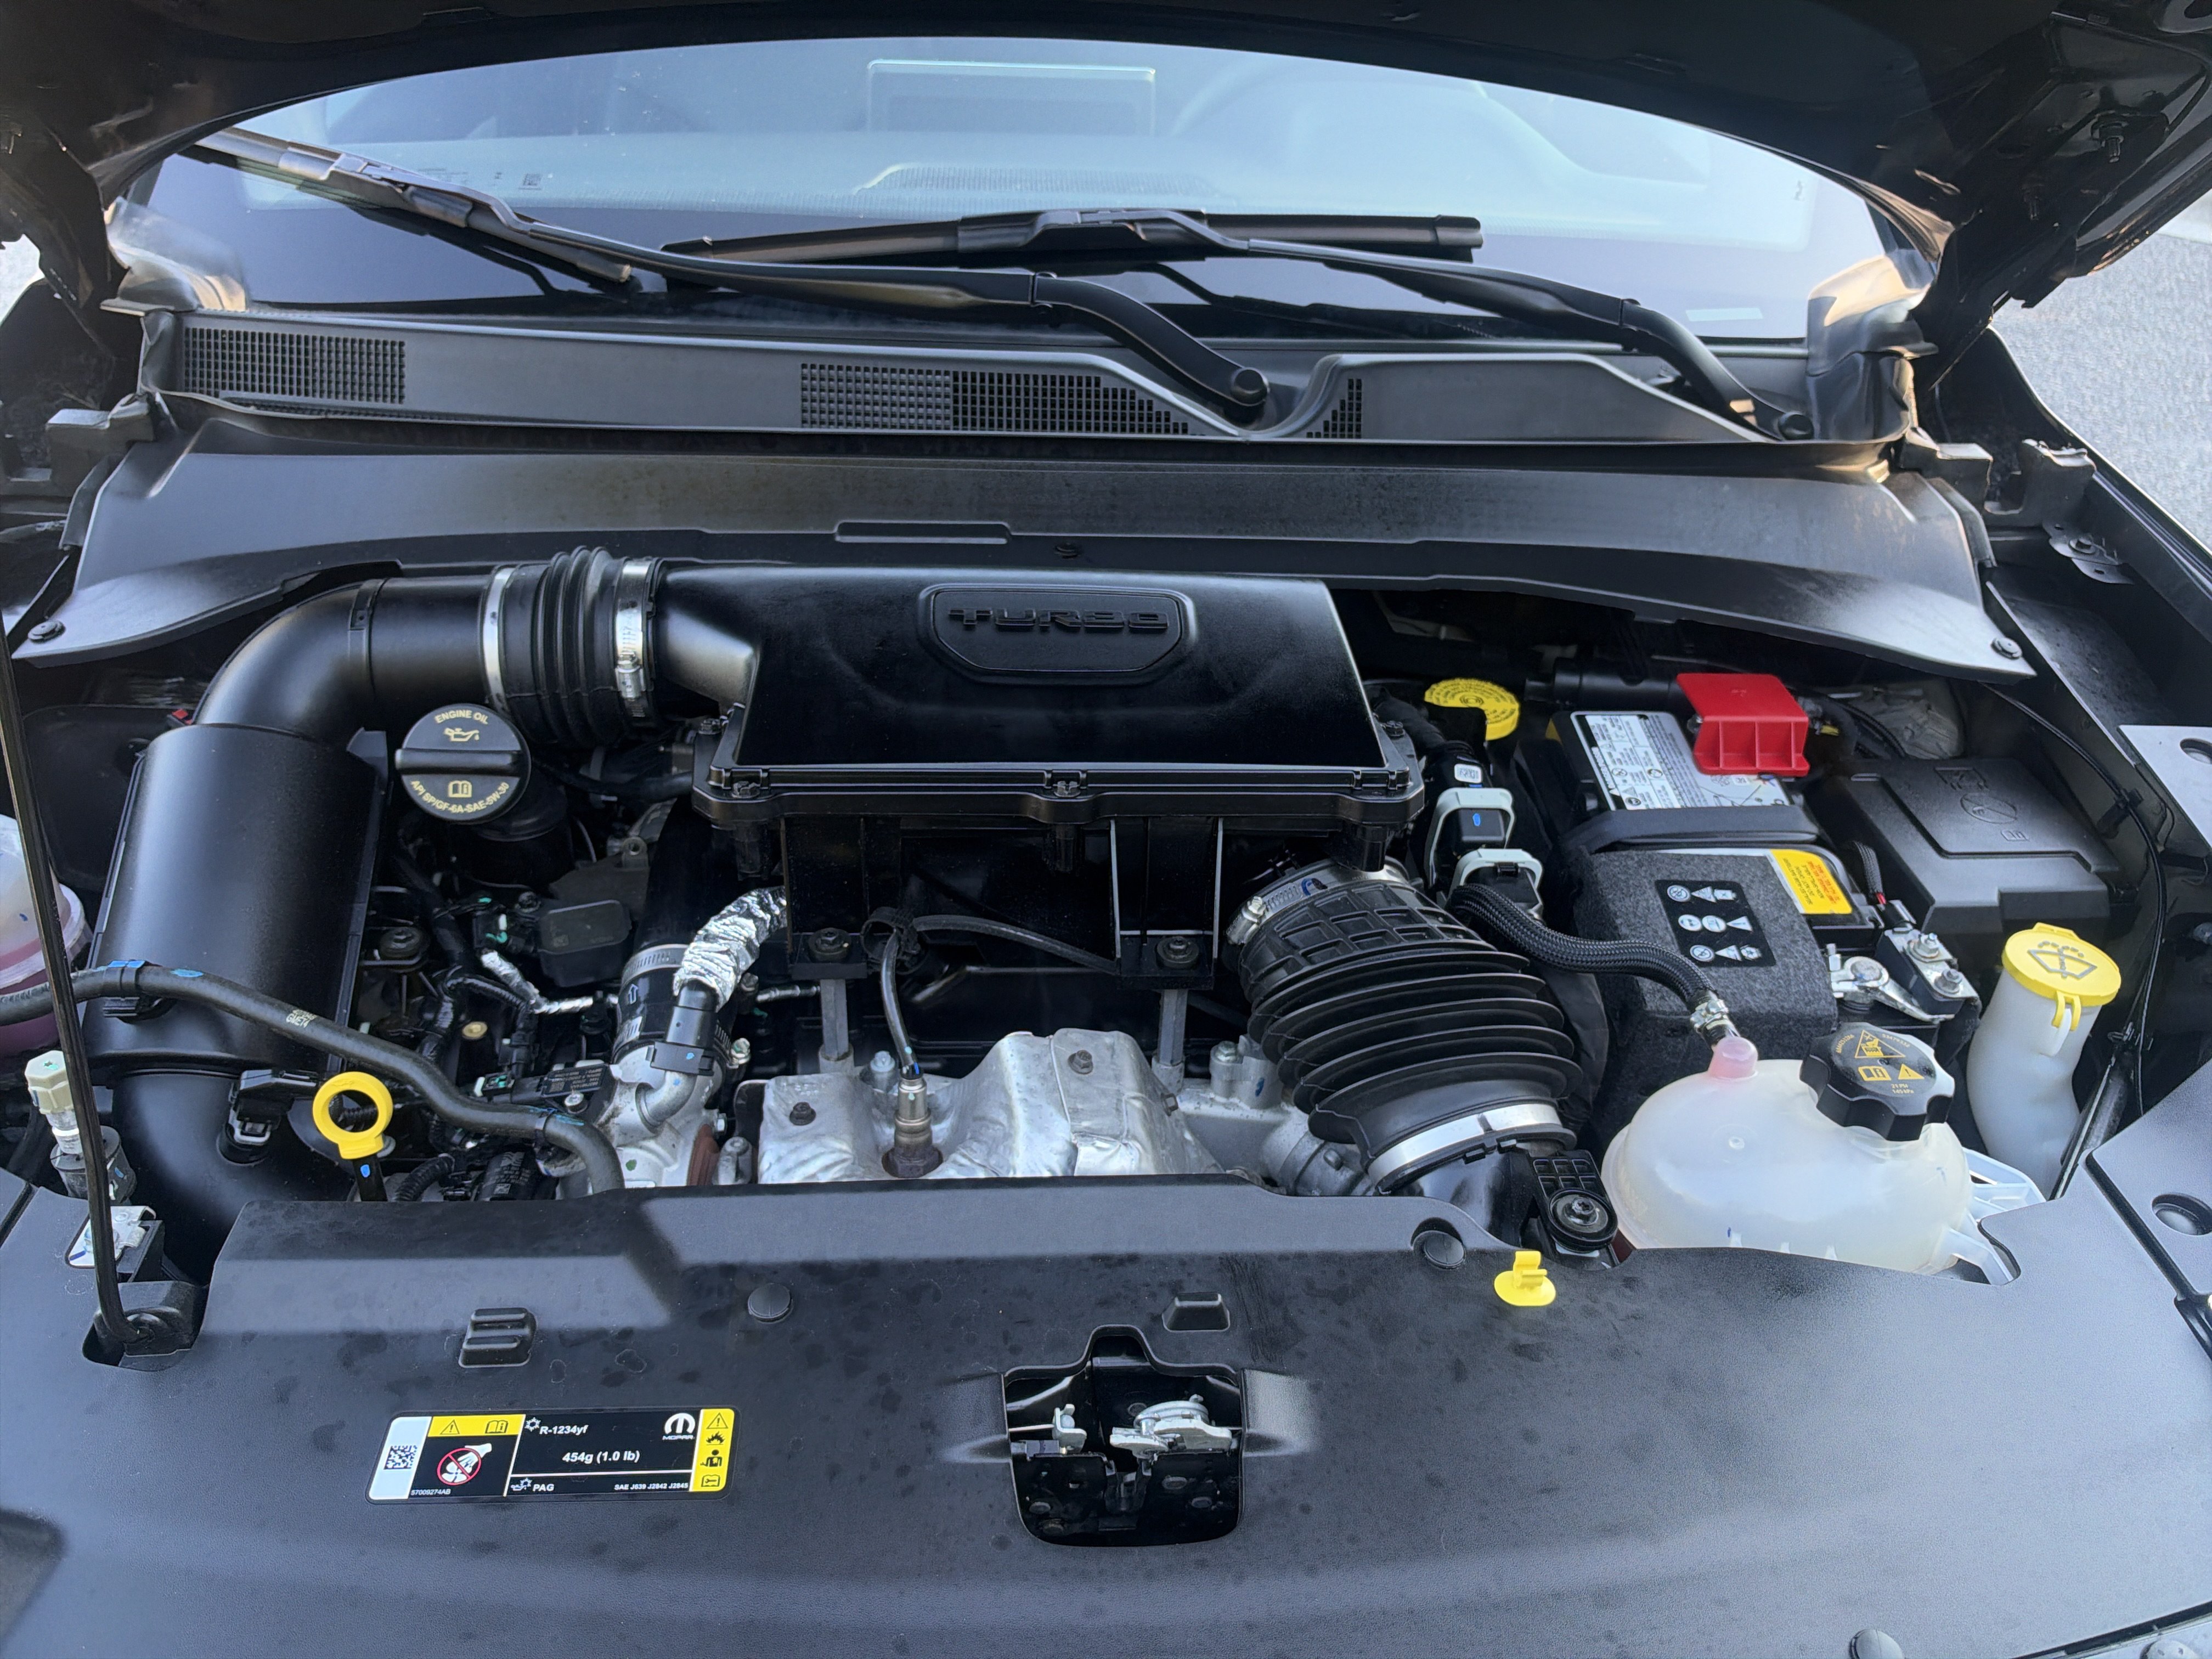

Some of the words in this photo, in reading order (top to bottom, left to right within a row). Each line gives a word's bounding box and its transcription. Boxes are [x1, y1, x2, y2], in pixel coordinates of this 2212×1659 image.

[949, 607, 1168, 629] TURBO
[434, 709, 472, 724] ENGINE
[473, 712, 488, 724] OIL
[410, 780, 426, 795] API
[539, 1425, 589, 1436] R-1234yf
[562, 1452, 594, 1464] 454g
[596, 1451, 620, 1464] (1.0
[623, 1450, 640, 1463] lb)
[532, 1483, 555, 1492] PAG
